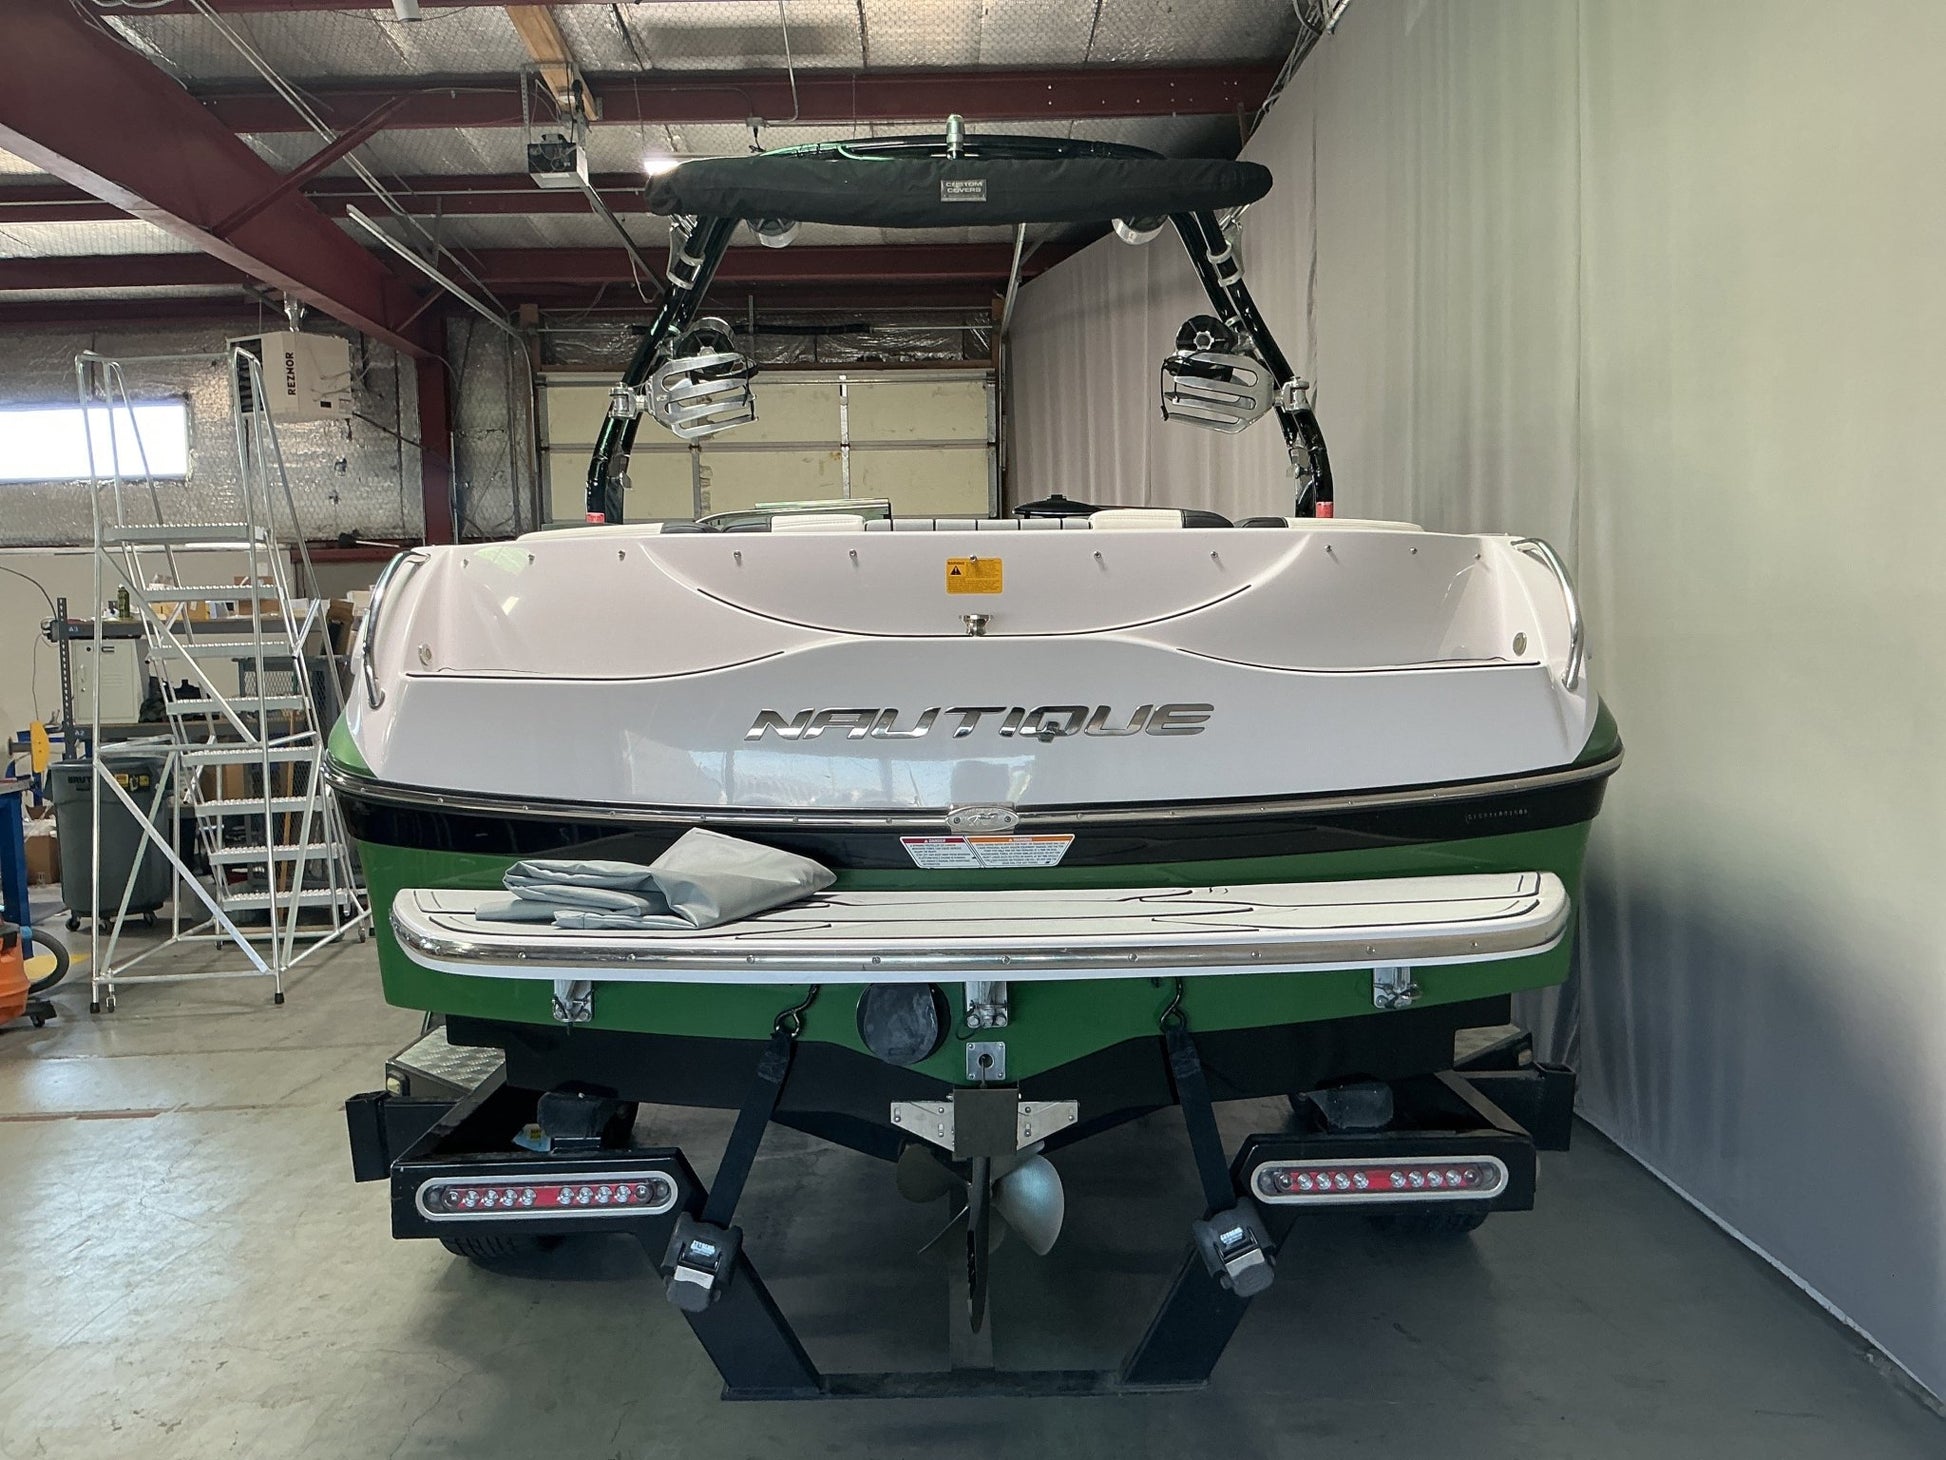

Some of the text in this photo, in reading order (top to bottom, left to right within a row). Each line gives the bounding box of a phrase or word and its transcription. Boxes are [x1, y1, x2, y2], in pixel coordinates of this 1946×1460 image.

[285, 352, 297, 396] REZNOR
[744, 703, 1215, 743] NAUTIQUE
[67, 775, 93, 784] BRUT
